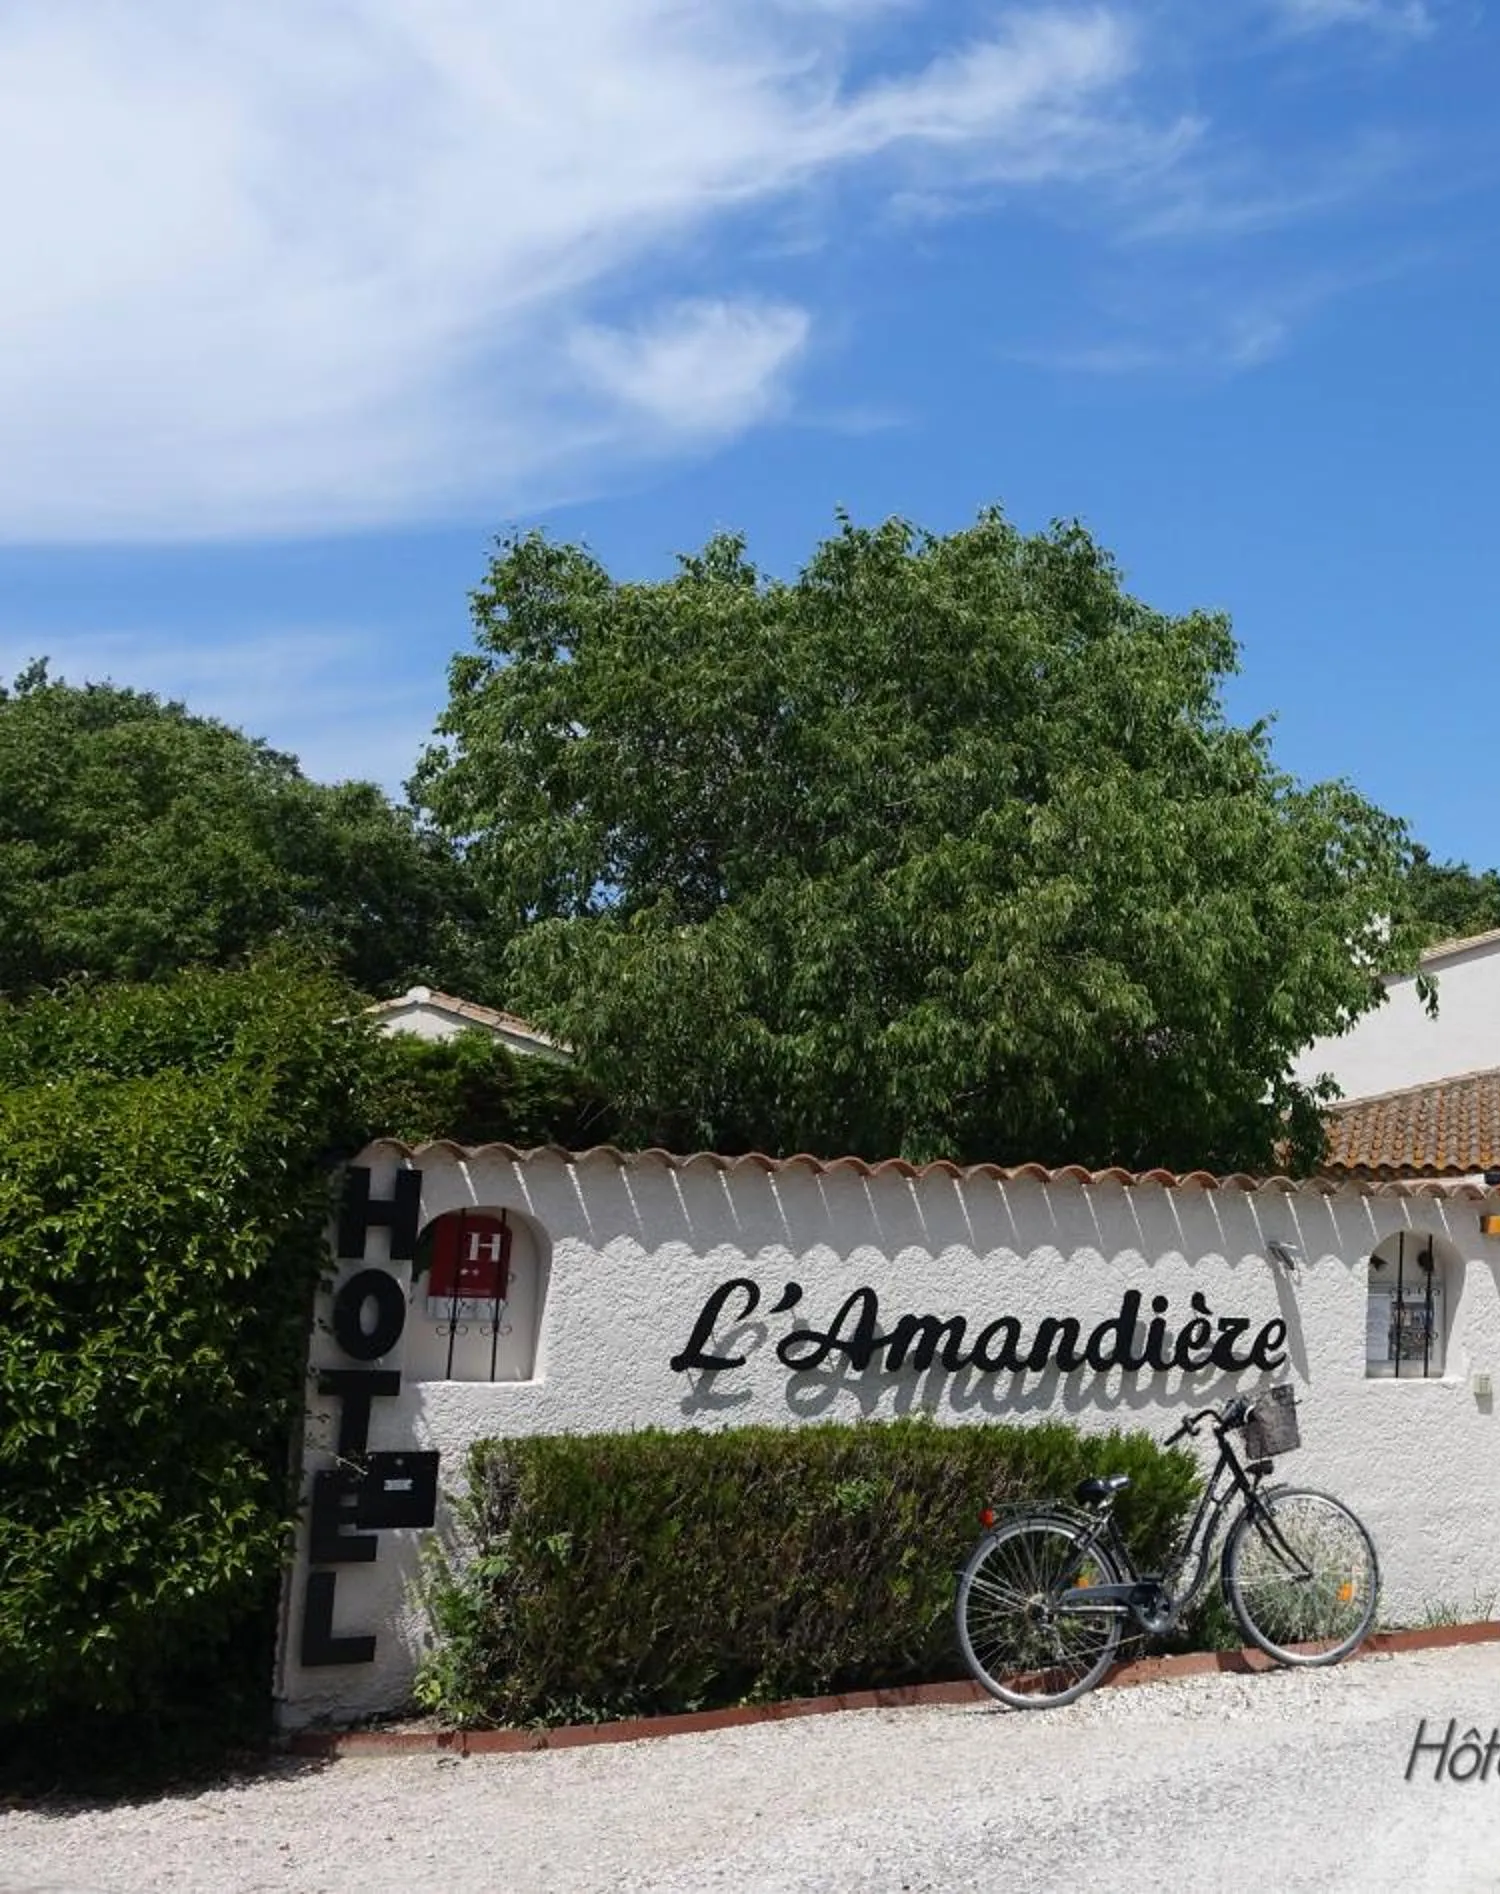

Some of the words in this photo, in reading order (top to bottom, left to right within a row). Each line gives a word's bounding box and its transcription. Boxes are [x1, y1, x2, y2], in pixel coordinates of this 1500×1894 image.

[464, 1232, 504, 1261] H
[671, 1278, 1287, 1373] L'Amandière
[302, 1167, 422, 1665] HOTEL
